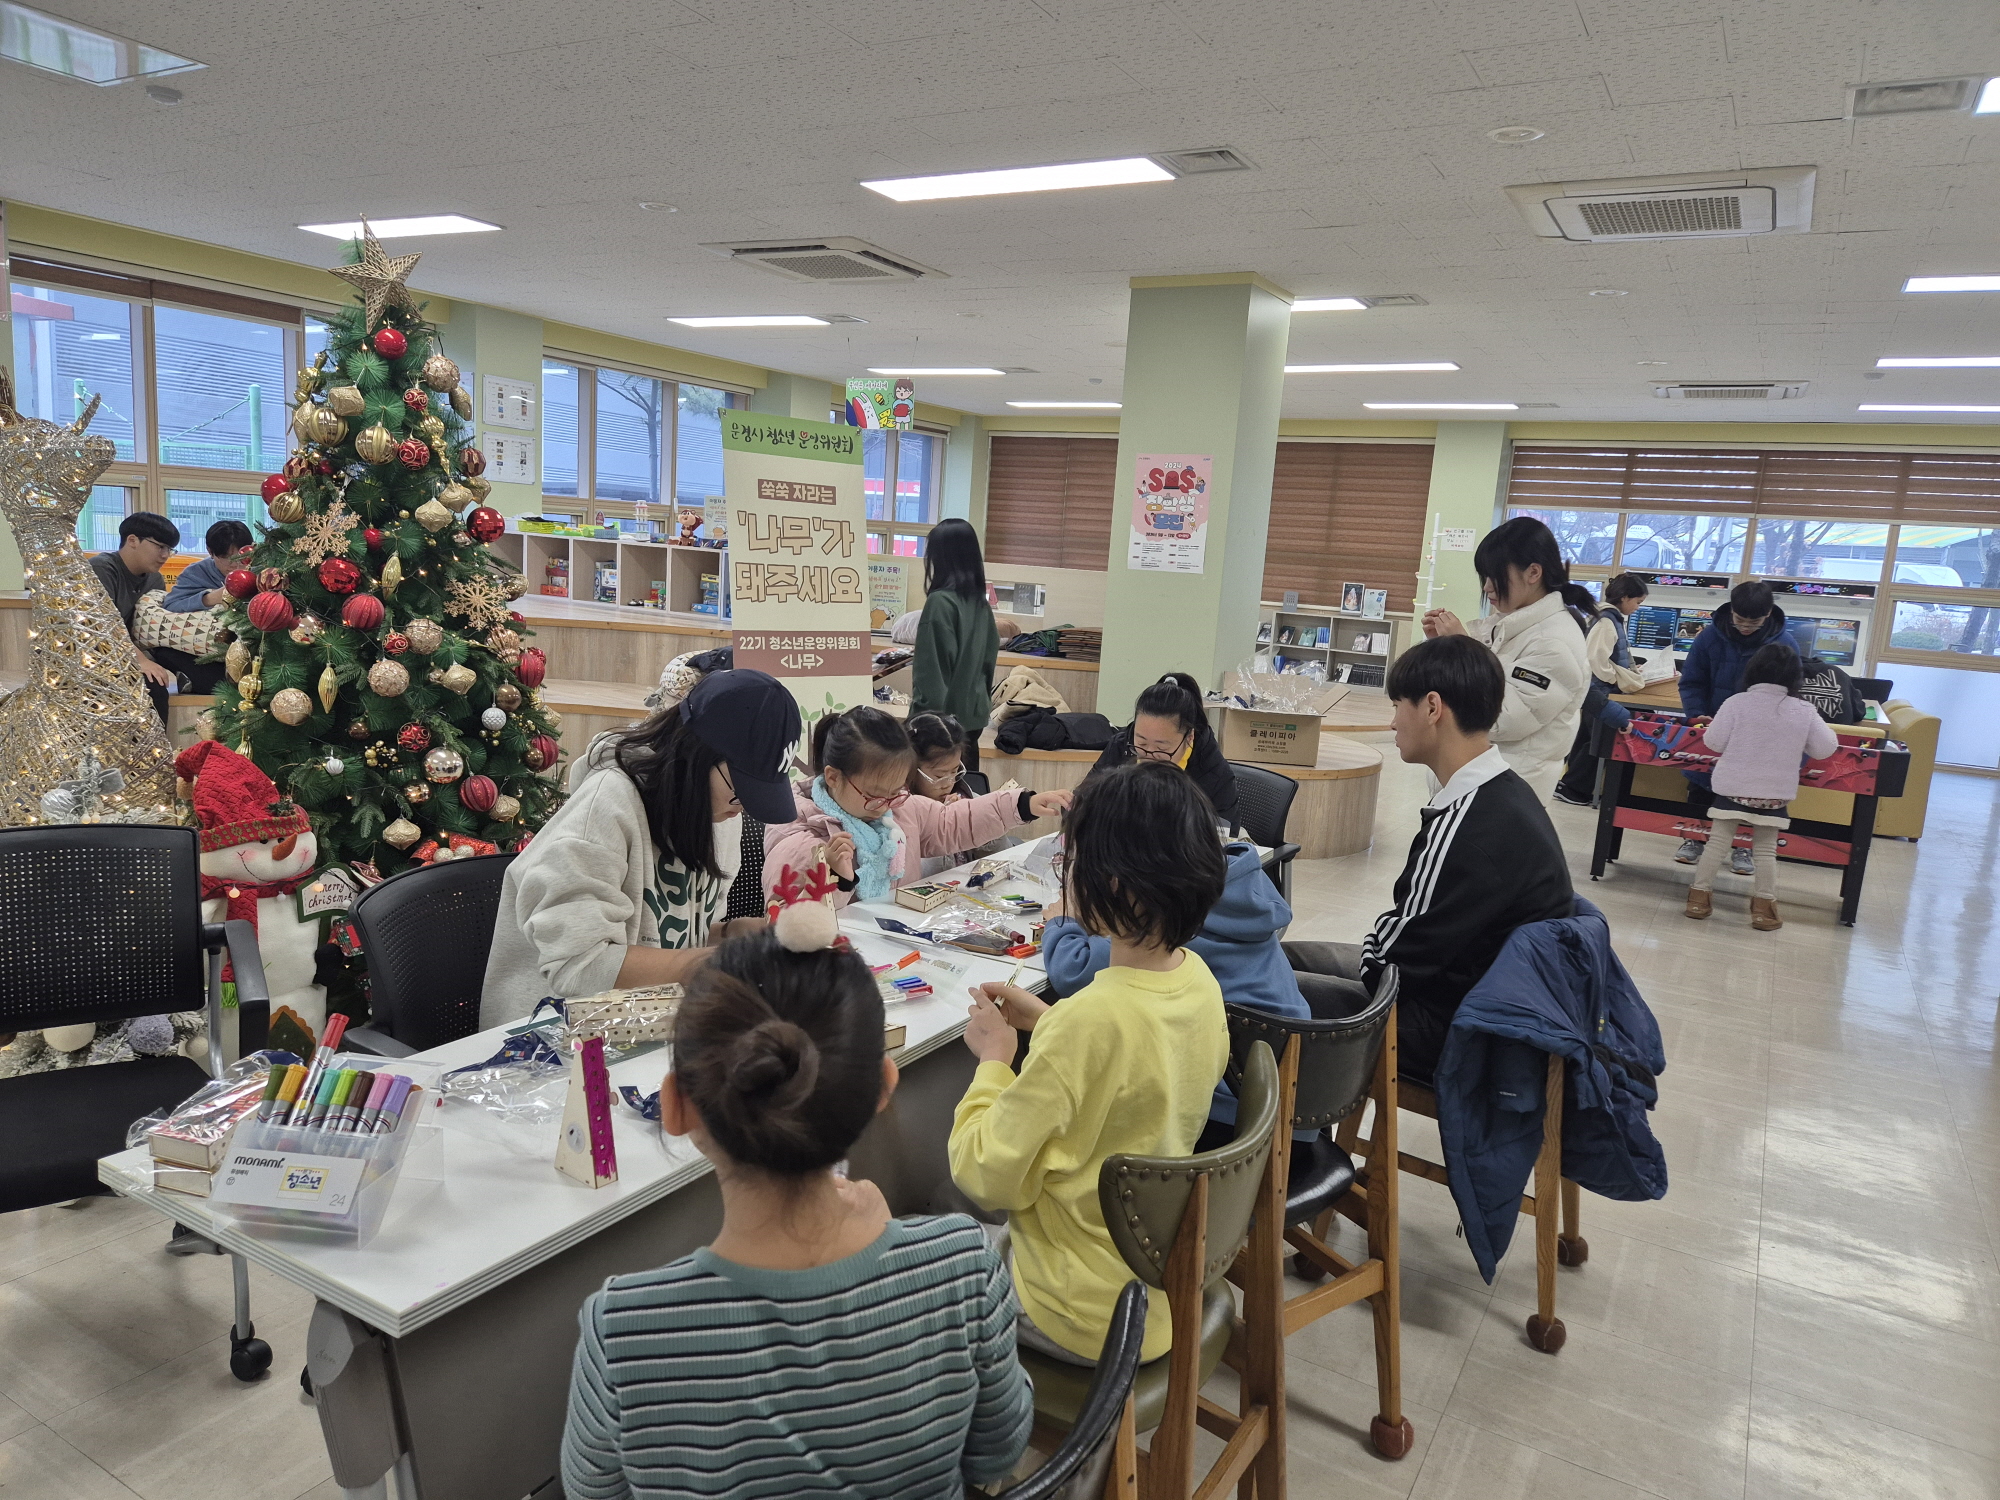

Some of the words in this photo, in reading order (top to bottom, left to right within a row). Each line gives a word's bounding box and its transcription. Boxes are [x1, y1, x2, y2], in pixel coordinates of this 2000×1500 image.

[731, 422, 764, 443] 문경시
[766, 426, 796, 446] 청소년
[798, 430, 854, 454] 운영위원회
[760, 480, 790, 500] 쑥쑥
[792, 484, 834, 504] 자라는
[736, 510, 855, 558] '나무'가
[735, 562, 862, 604] 돼주세요
[739, 636, 766, 650] 22기
[769, 636, 861, 650] 청소년운영위원회
[780, 653, 824, 670] <나무>
[1250, 730, 1296, 740] 클레이피아
[287, 1172, 323, 1190] 청소년
[329, 1193, 347, 1207] 24
